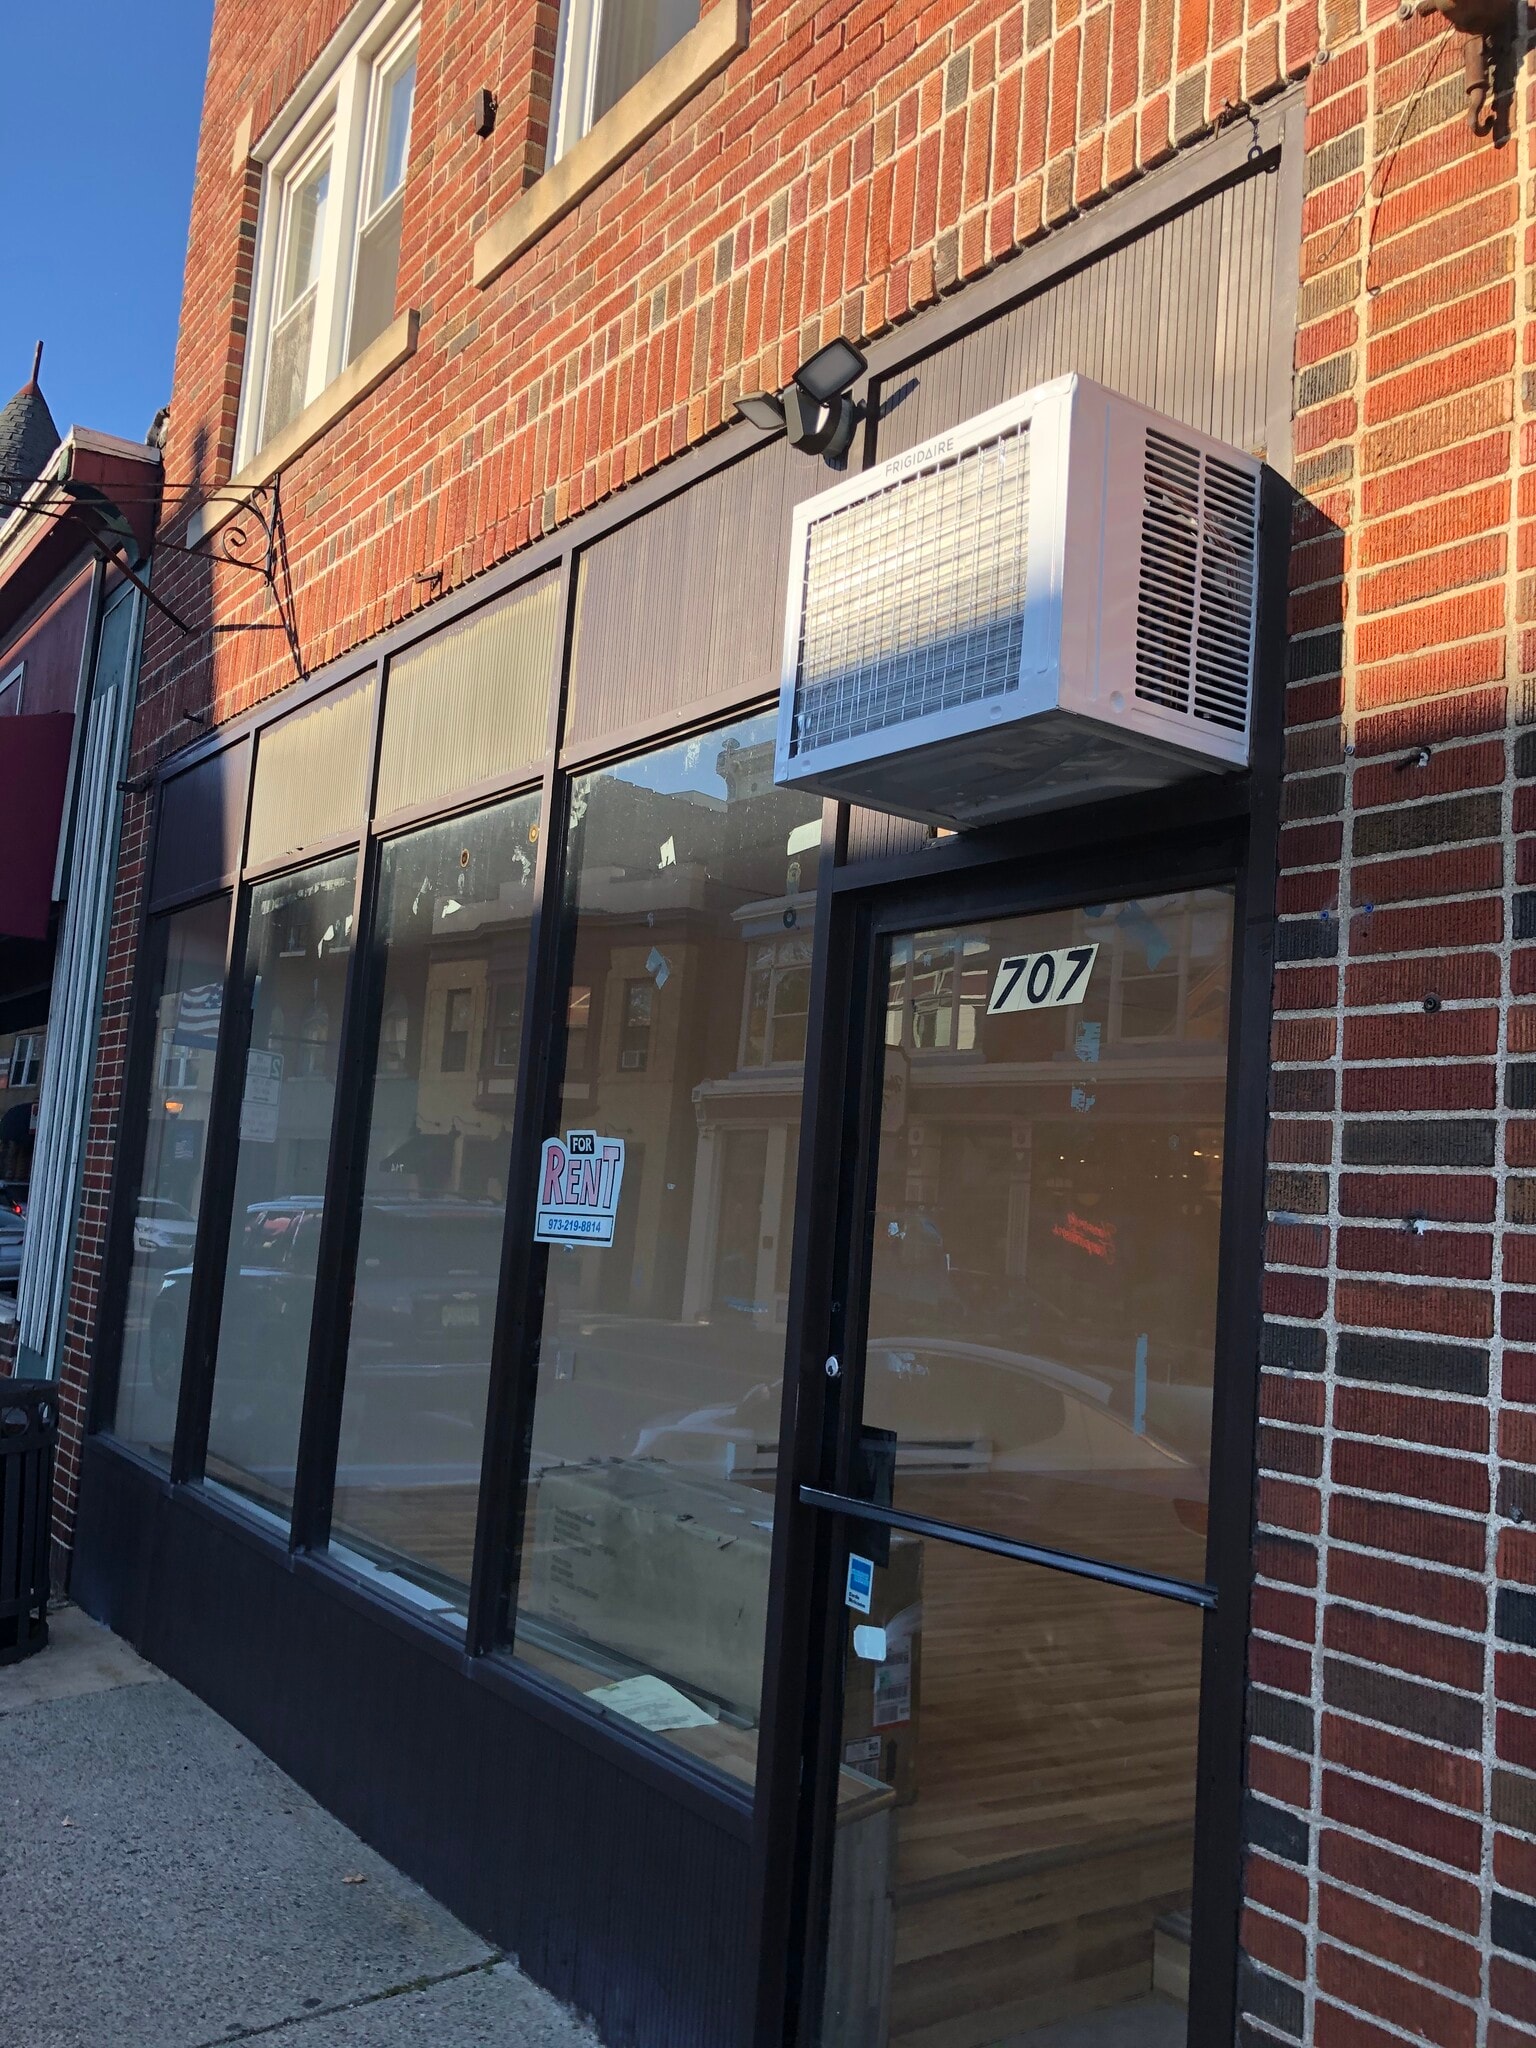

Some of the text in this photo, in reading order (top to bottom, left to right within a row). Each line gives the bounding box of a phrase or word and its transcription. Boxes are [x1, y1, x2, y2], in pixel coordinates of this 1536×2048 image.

[885, 437, 954, 477] FRIGIDAIRE
[993, 947, 1094, 1009] 707
[572, 1136, 593, 1153] FOR
[542, 1145, 621, 1209] RENT
[548, 1218, 602, 1233] 973-219-8814
